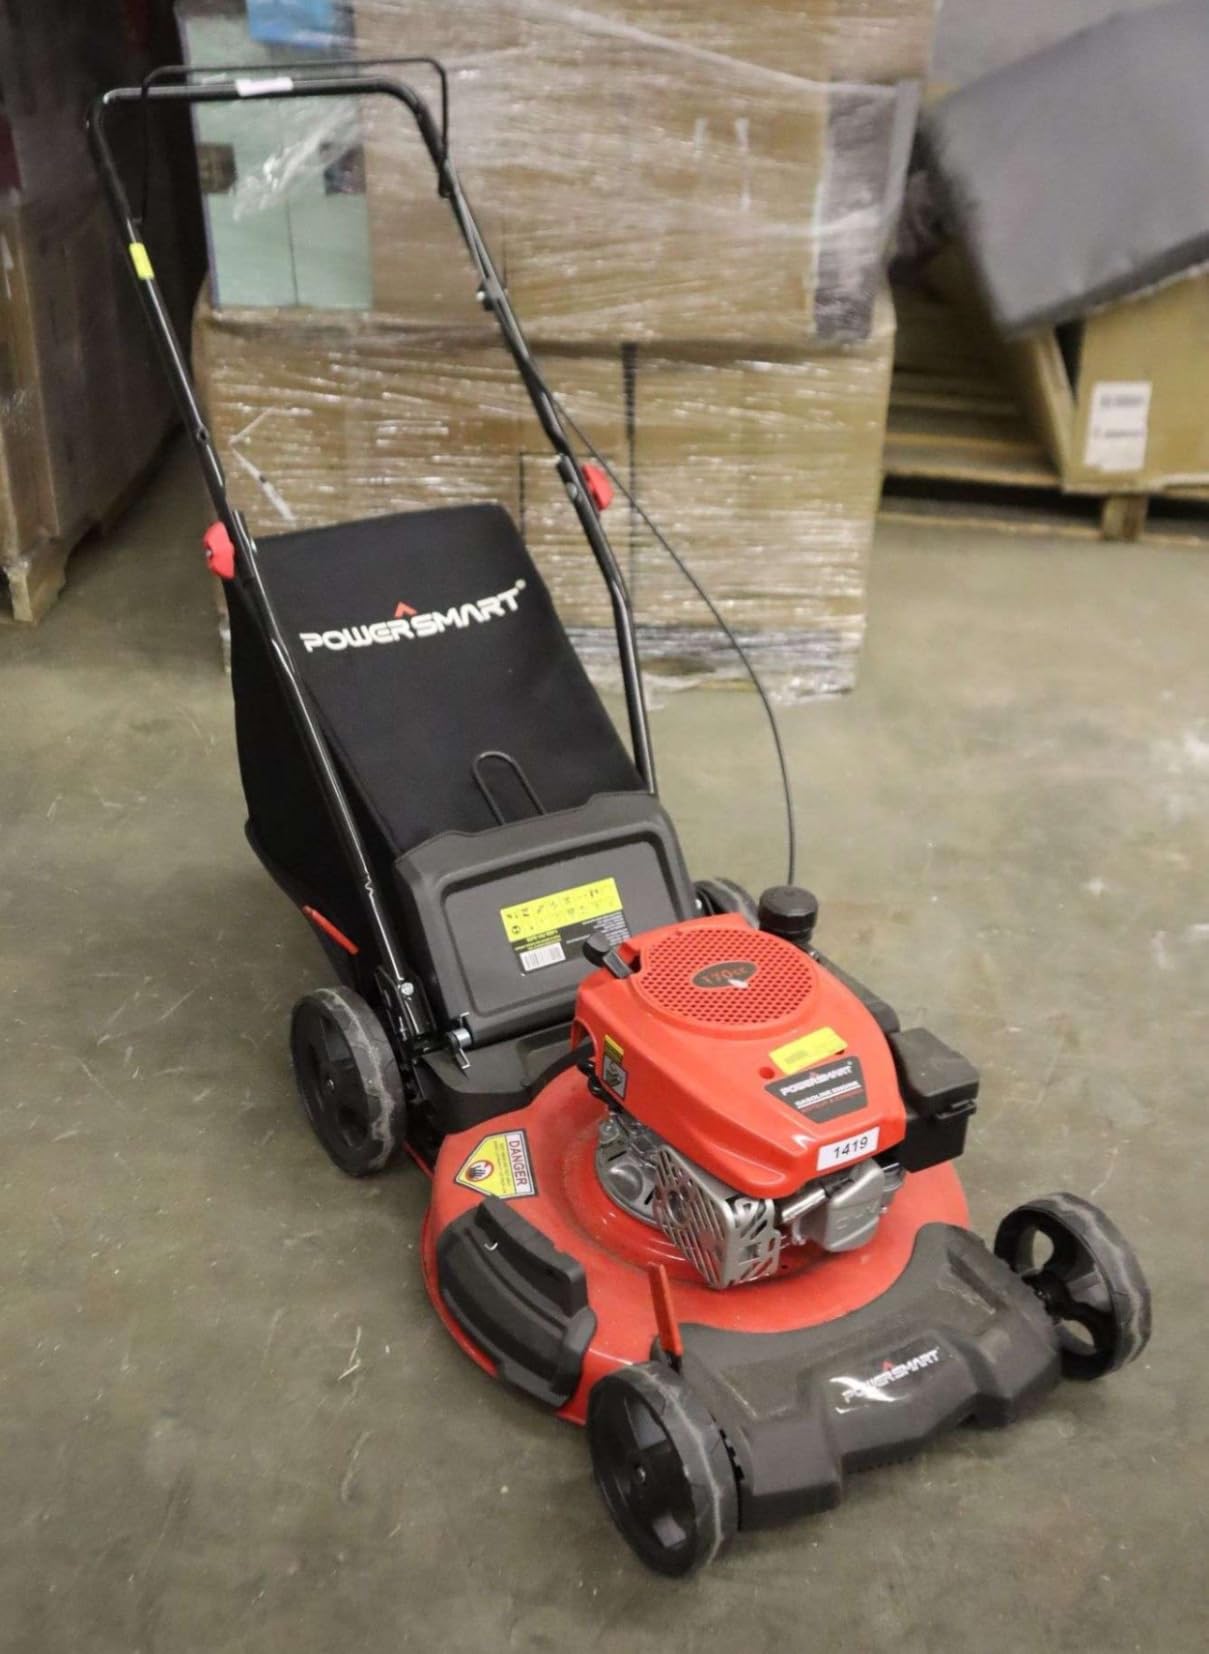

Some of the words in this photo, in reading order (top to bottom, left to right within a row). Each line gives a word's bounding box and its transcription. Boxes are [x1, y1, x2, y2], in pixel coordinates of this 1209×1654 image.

[299, 588, 519, 652] POWERSMART
[508, 1140, 528, 1187] DANGER
[834, 1136, 868, 1158] 1419
